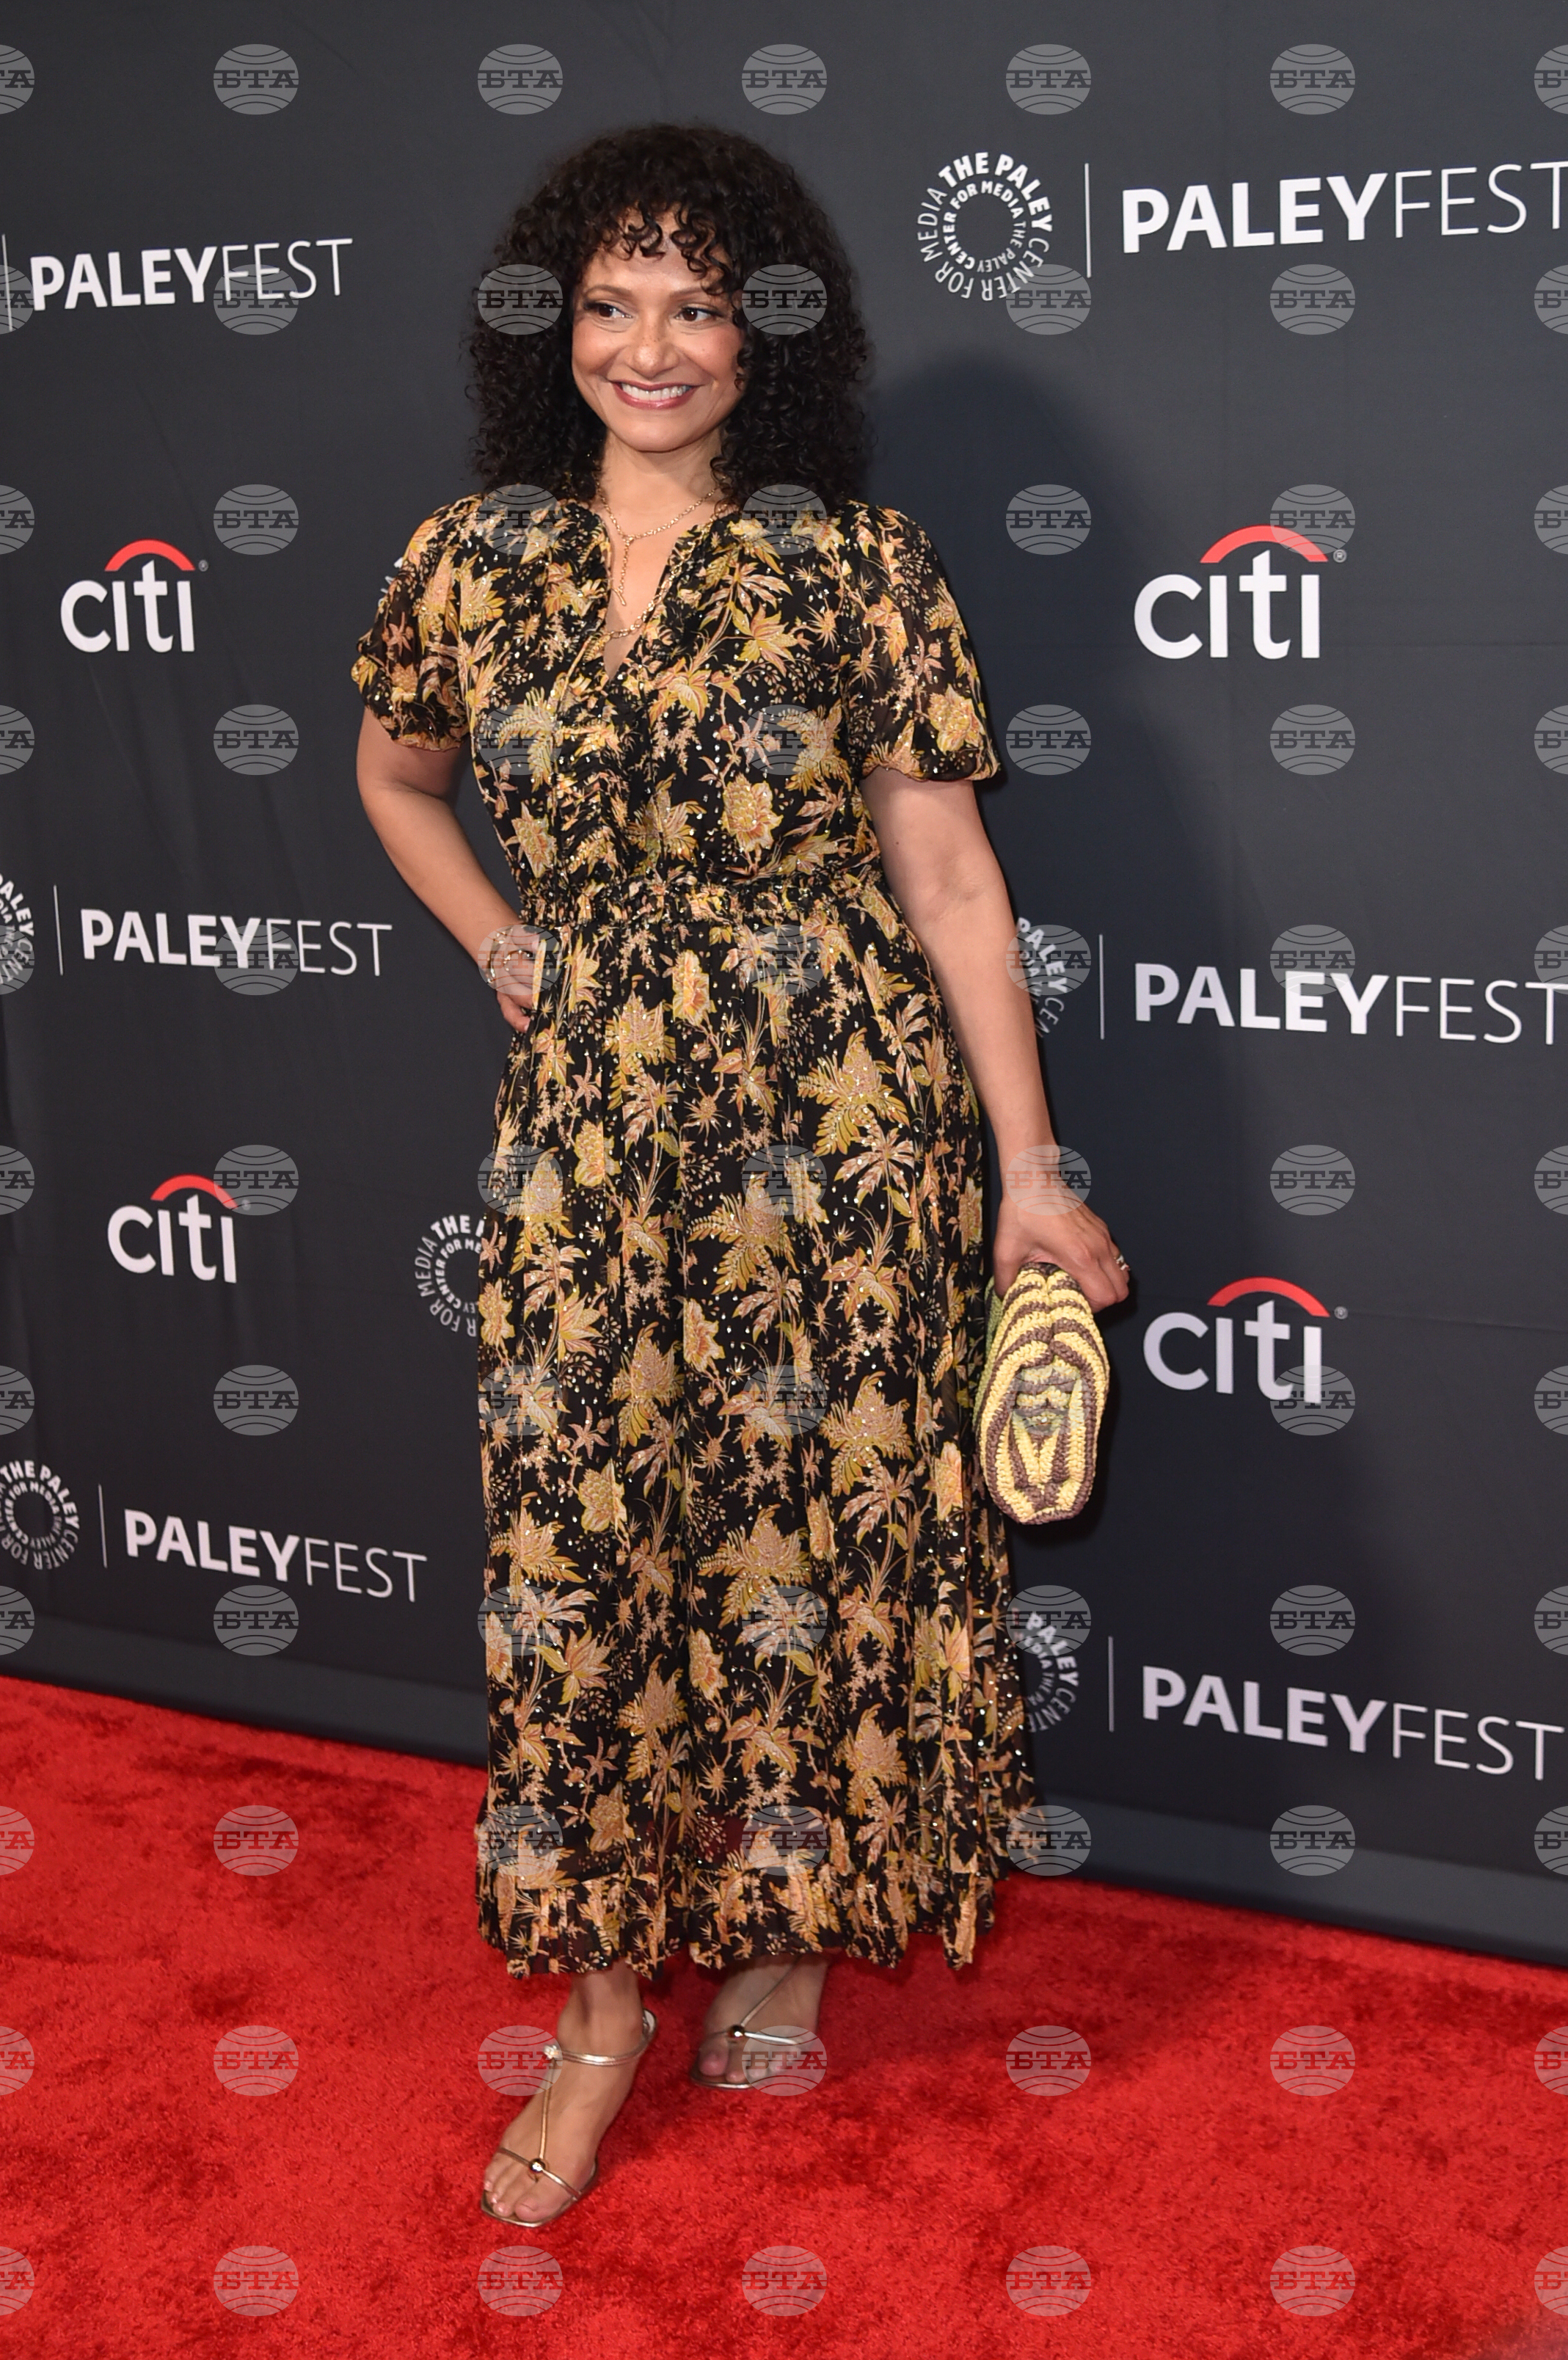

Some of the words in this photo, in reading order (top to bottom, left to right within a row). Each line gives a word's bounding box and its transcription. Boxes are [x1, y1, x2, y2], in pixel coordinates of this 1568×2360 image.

[938, 152, 989, 188] THE
[949, 183, 978, 210] FOR
[981, 181, 1024, 219] MEDIA
[994, 153, 1053, 232] PALEY
[917, 188, 948, 262] MEDIA
[943, 211, 975, 269] CENTER
[1010, 221, 1027, 248] THE
[1122, 161, 1568, 253] PALEYFEST
[30, 238, 353, 311] PALEYFEST
[935, 261, 974, 299] FOR
[977, 247, 1016, 273] PALEY
[981, 238, 1050, 301] CENTER
[60, 560, 194, 652] citi
[1134, 550, 1320, 660] citi
[0, 873, 34, 937] ALEY
[81, 908, 393, 977] PALEYFEST
[1135, 963, 1568, 1045] PALEYFEST
[107, 1195, 236, 1283] citi
[430, 1214, 471, 1240] THE
[440, 1239, 462, 1259] FOR
[415, 1237, 438, 1297] MEDIA
[435, 1259, 462, 1309] CENTER
[429, 1299, 461, 1332] FOR
[1143, 1300, 1322, 1404] citi
[0, 1460, 35, 1483] THE
[40, 1464, 80, 1529] PALEY
[125, 1509, 427, 1602] PALEYFEST
[1026, 1612, 1079, 1687] PALEY
[1143, 1667, 1564, 1780] PALEYFEST
